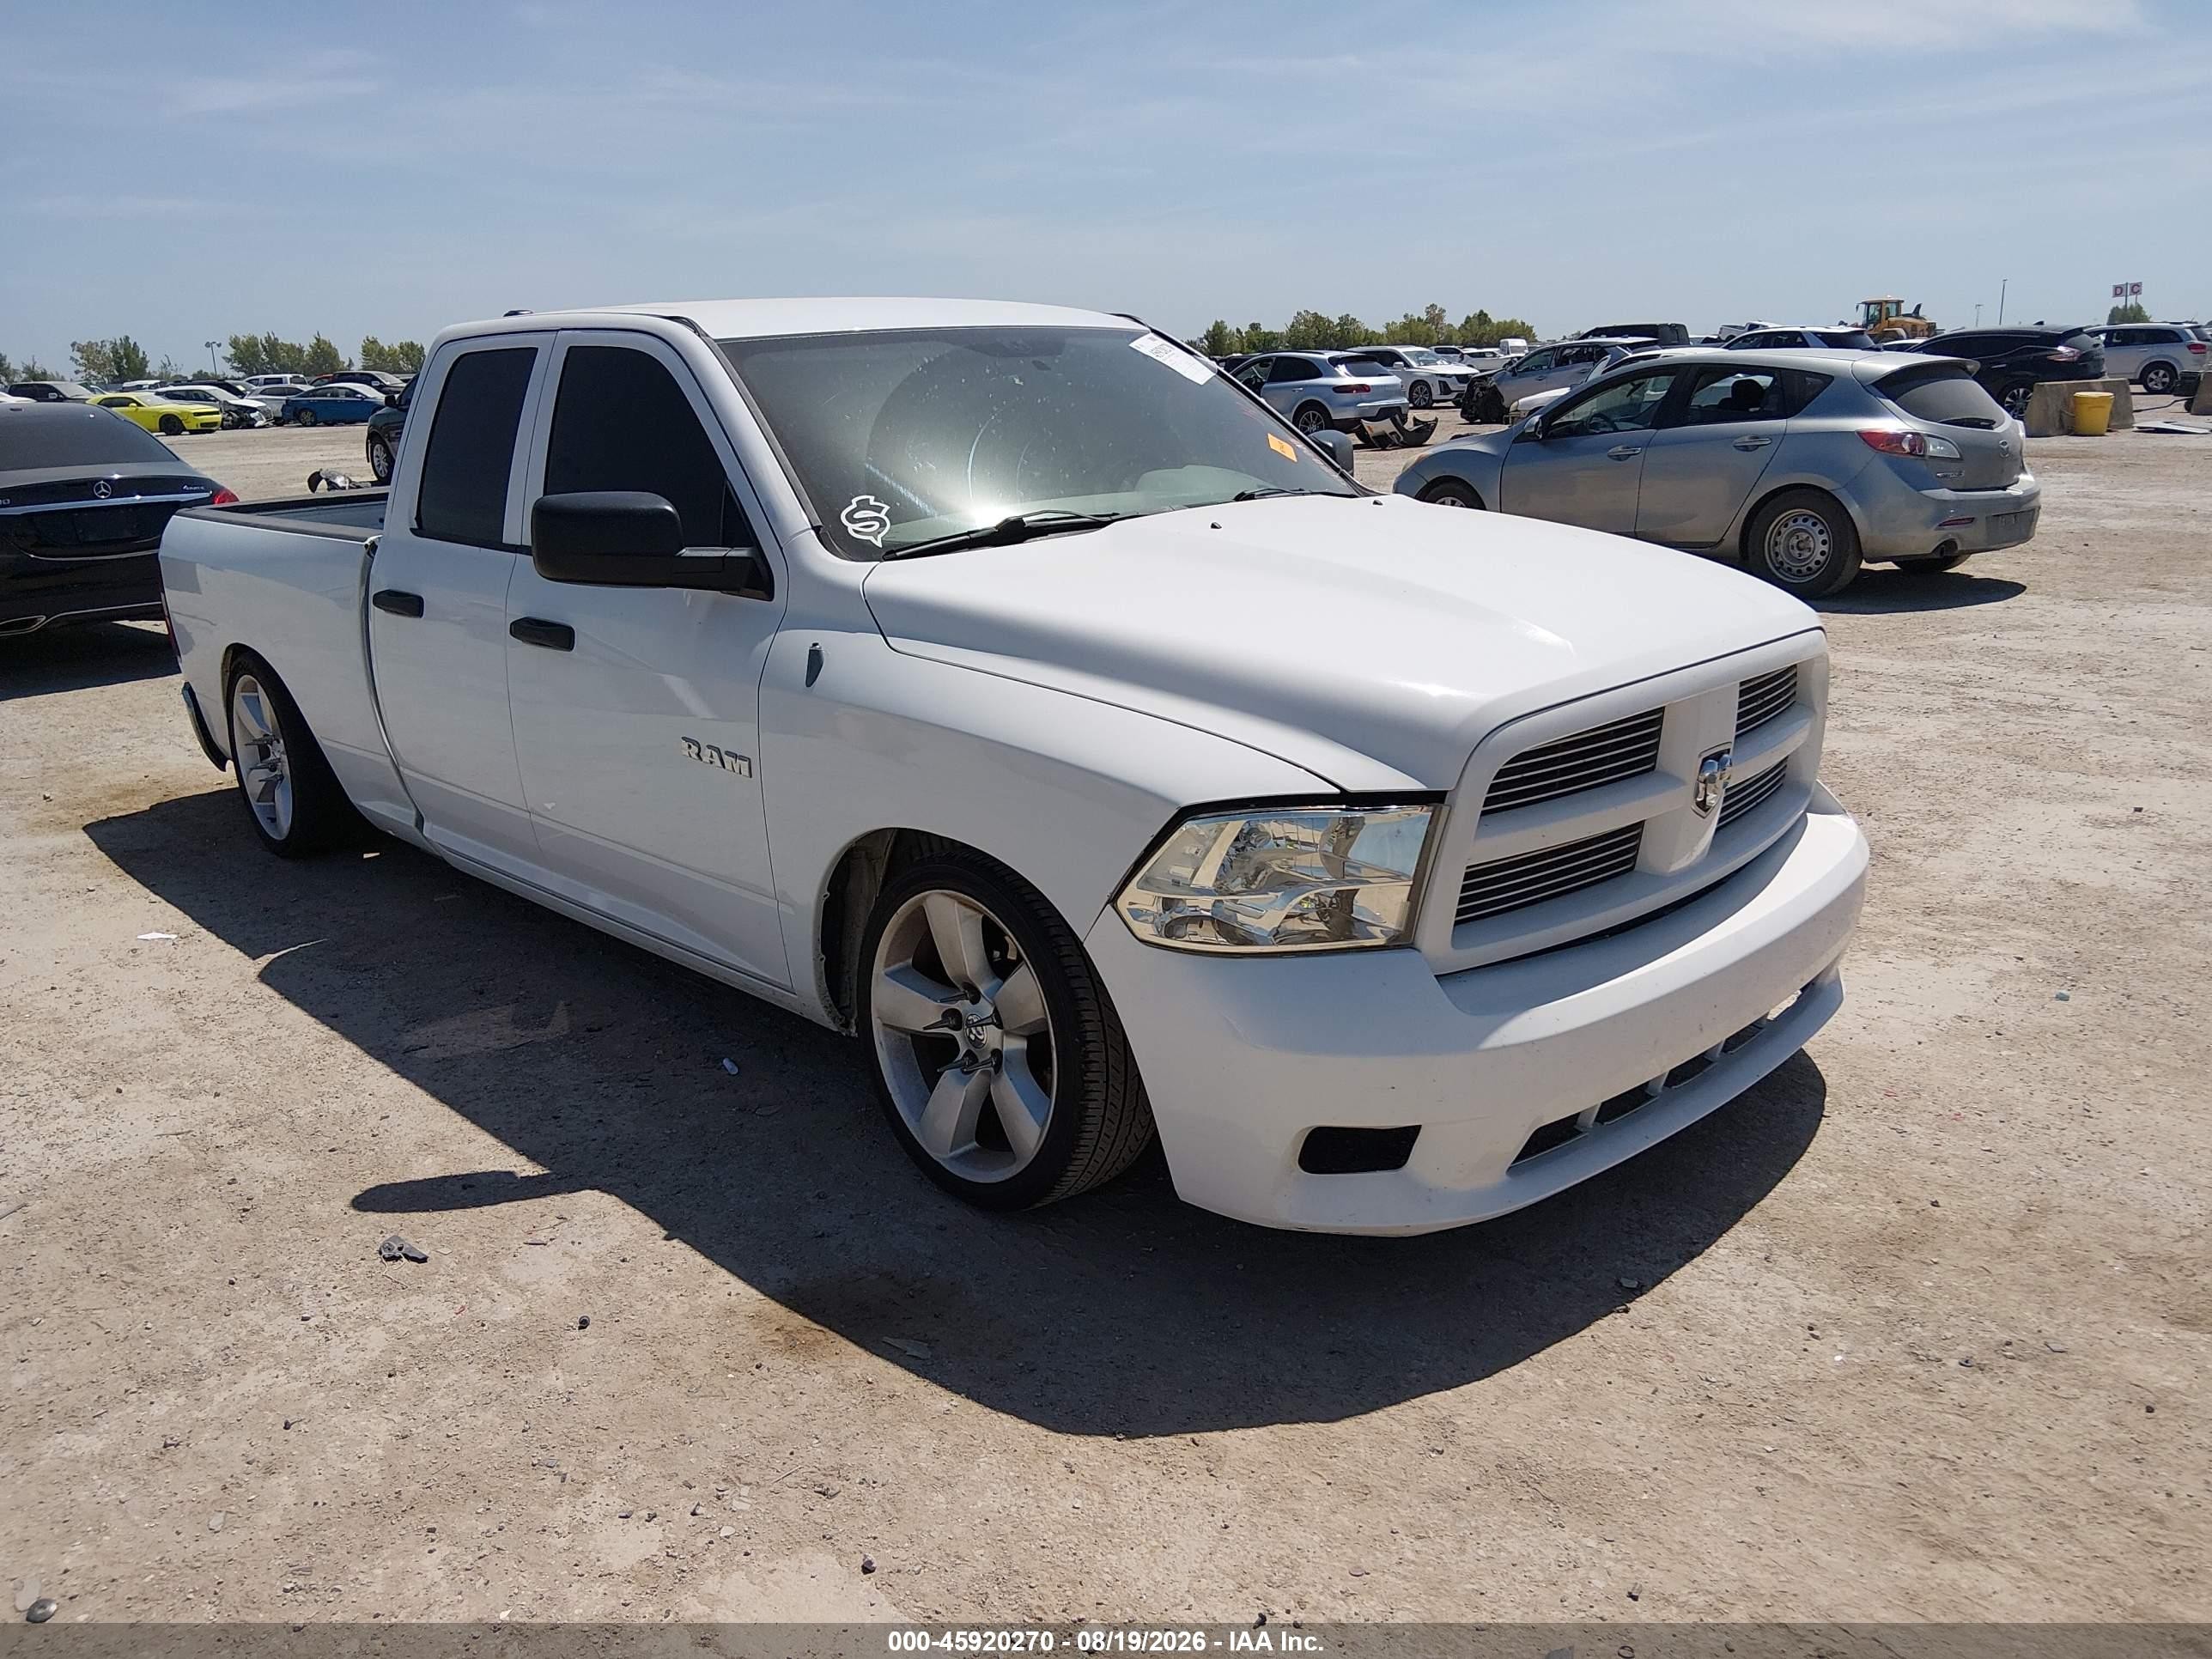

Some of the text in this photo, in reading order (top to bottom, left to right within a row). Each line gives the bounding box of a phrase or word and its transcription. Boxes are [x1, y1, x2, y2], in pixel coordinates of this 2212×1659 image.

[2115, 286, 2123, 296] D
[2131, 284, 2140, 294] C
[681, 736, 752, 778] RAM
